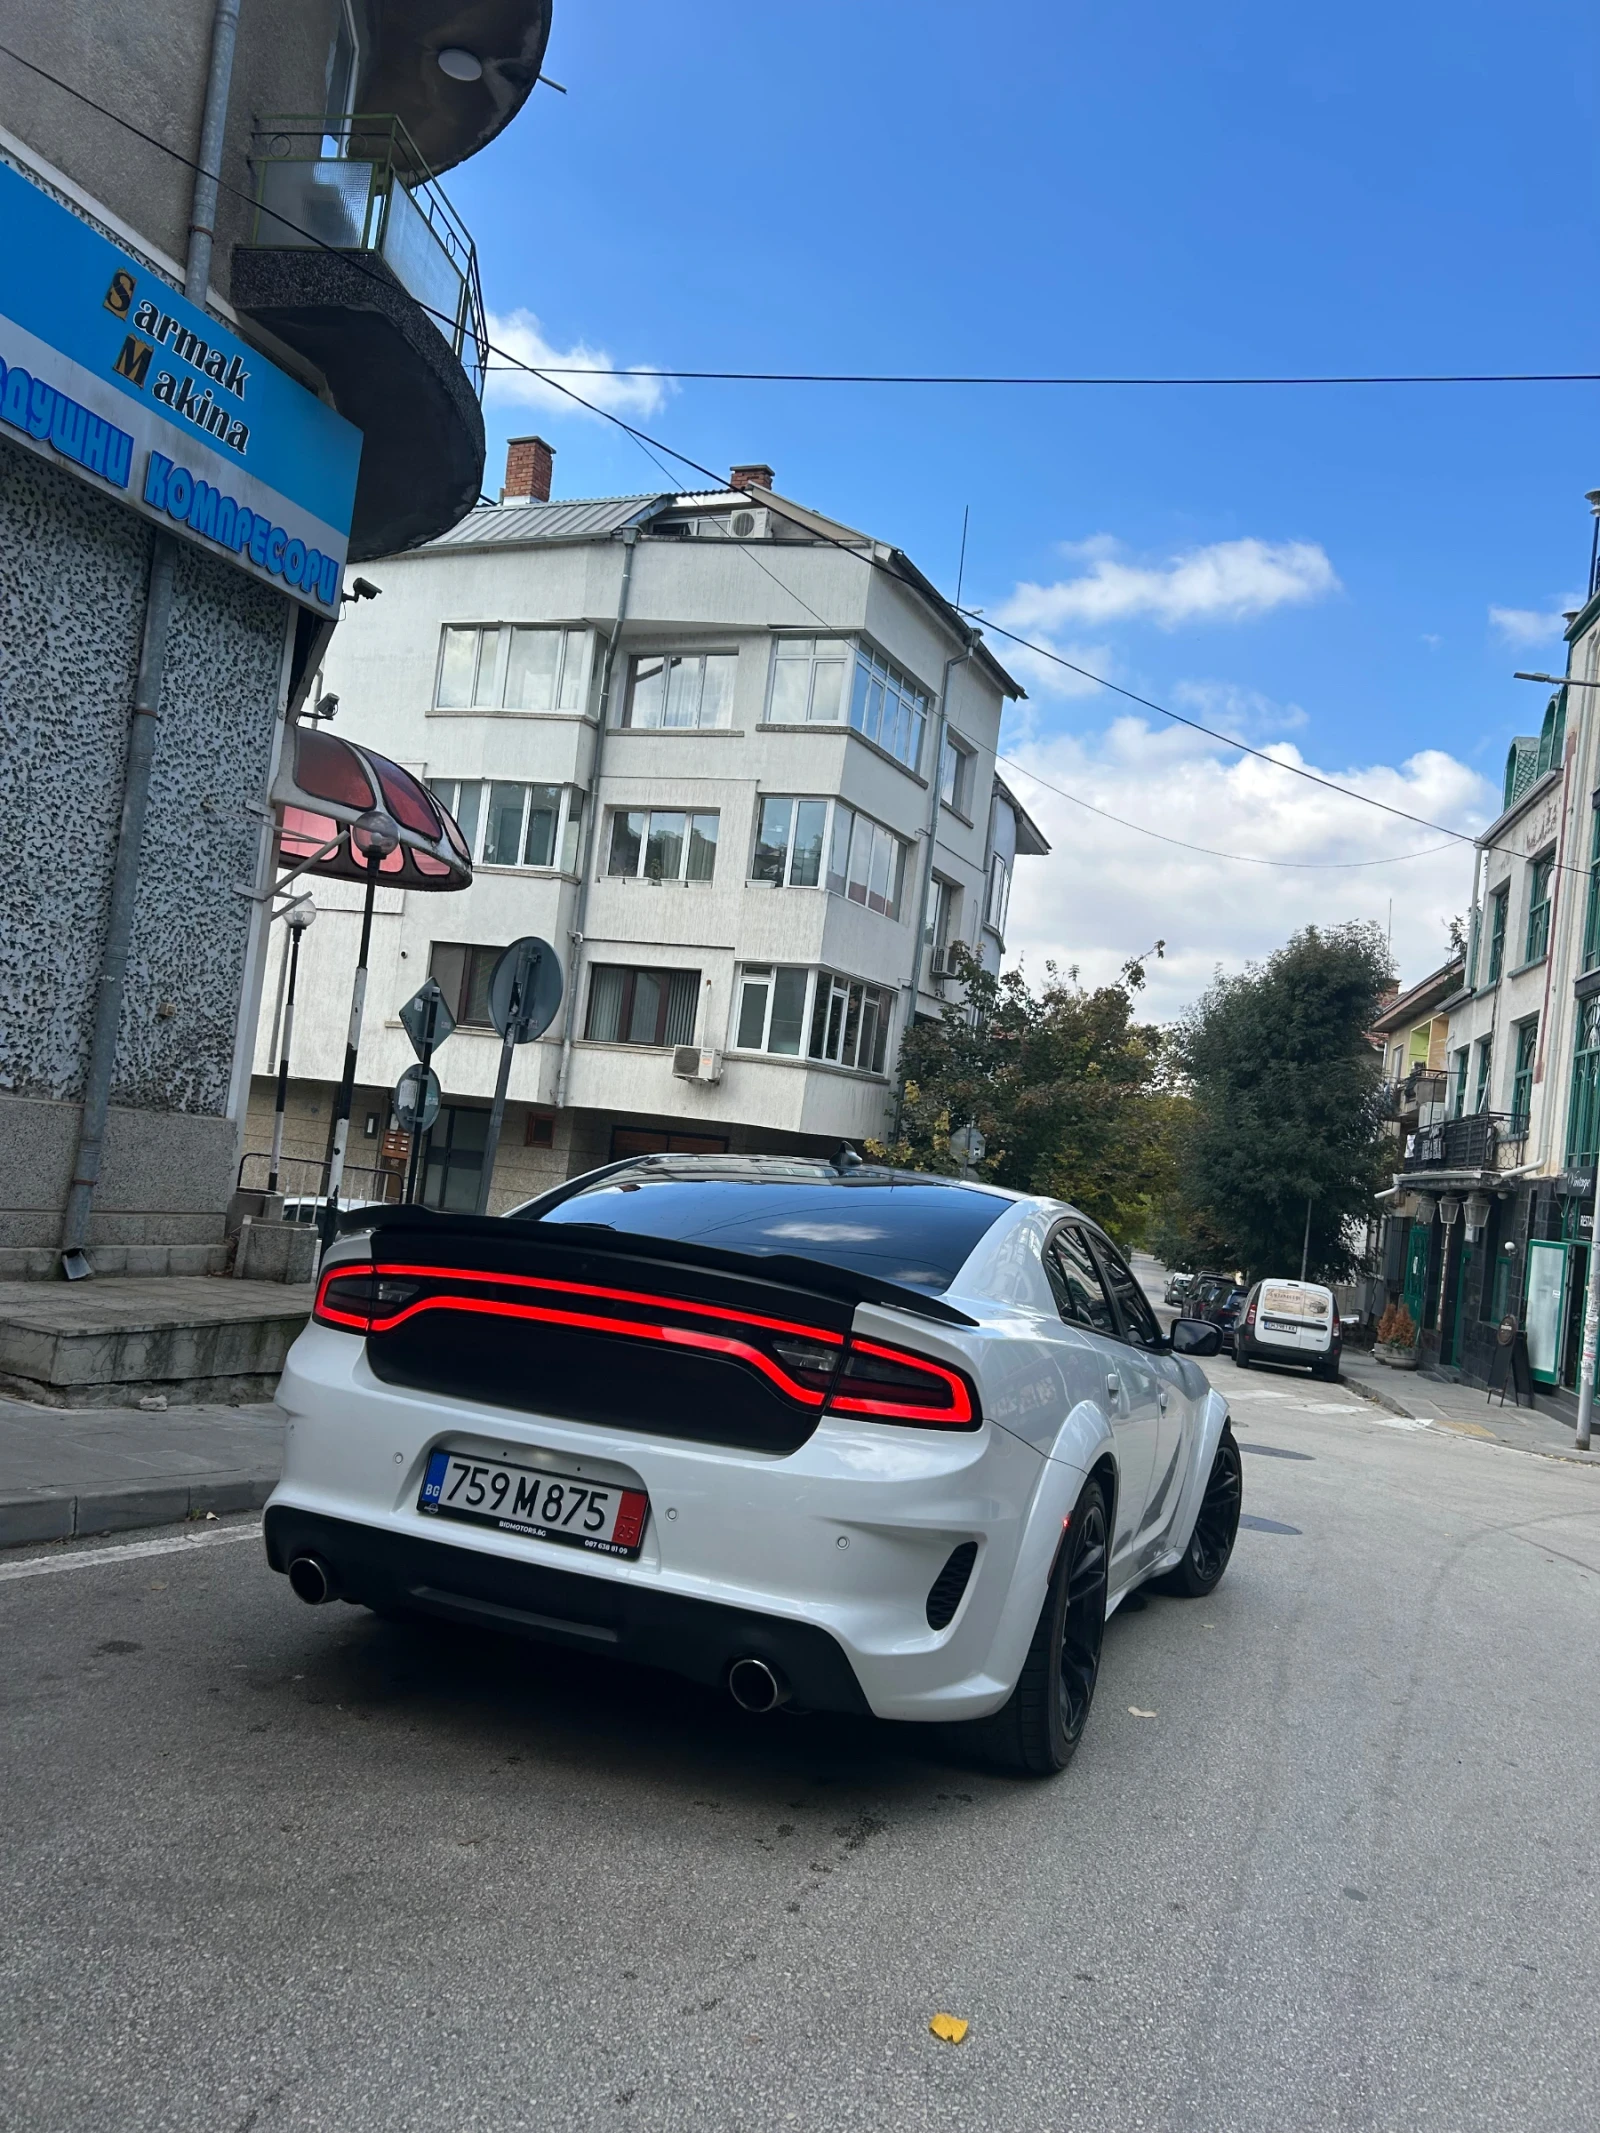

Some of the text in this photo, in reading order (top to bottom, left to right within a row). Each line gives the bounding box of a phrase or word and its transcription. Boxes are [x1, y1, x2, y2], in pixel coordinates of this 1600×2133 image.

[105, 270, 251, 400] Sarmak
[114, 335, 250, 455] Makina
[145, 450, 339, 604] КОМПРЕСОРИ
[1568, 1170, 1591, 1194] Vintage
[425, 1483, 440, 1498] BG
[499, 1520, 547, 1537] BIDMOTORS.BG
[616, 1524, 636, 1540] 25
[619, 1547, 628, 1555] 09
